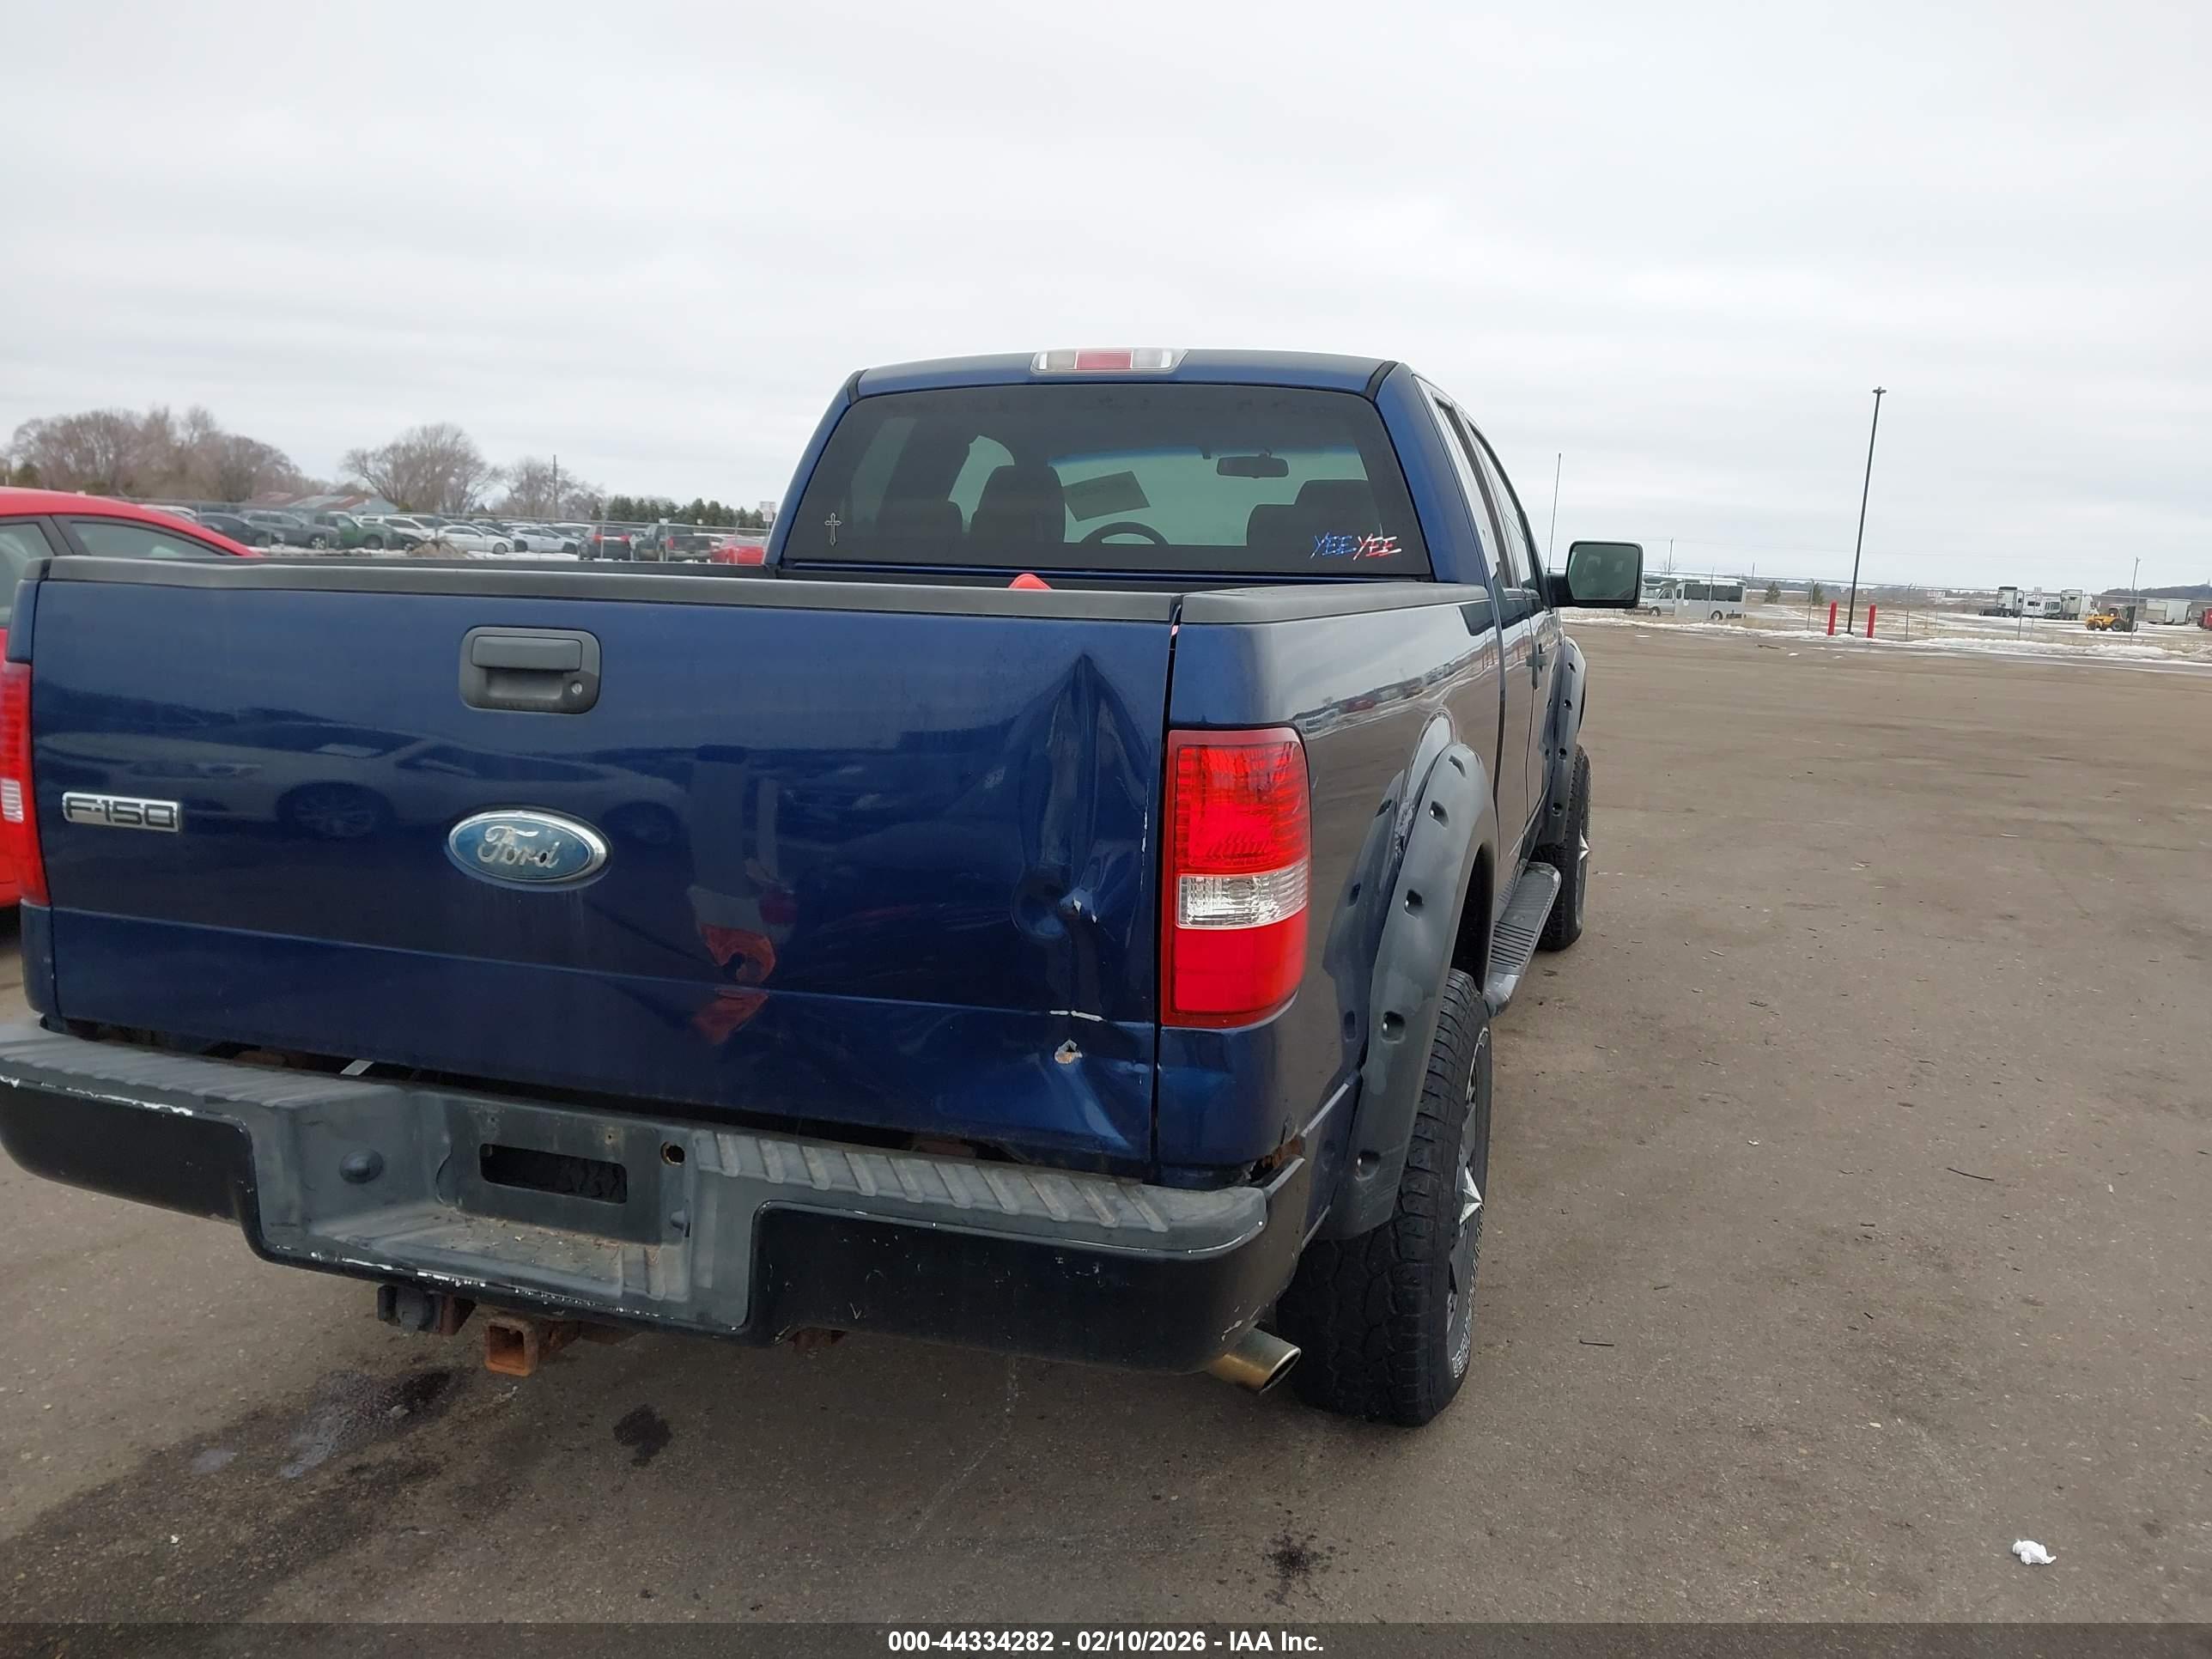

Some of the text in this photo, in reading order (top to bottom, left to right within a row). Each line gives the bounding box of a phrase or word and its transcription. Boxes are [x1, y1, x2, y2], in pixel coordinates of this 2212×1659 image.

[1310, 532, 1402, 561] YEE YEE
[65, 796, 175, 829] F-150
[477, 824, 561, 869] Ford
